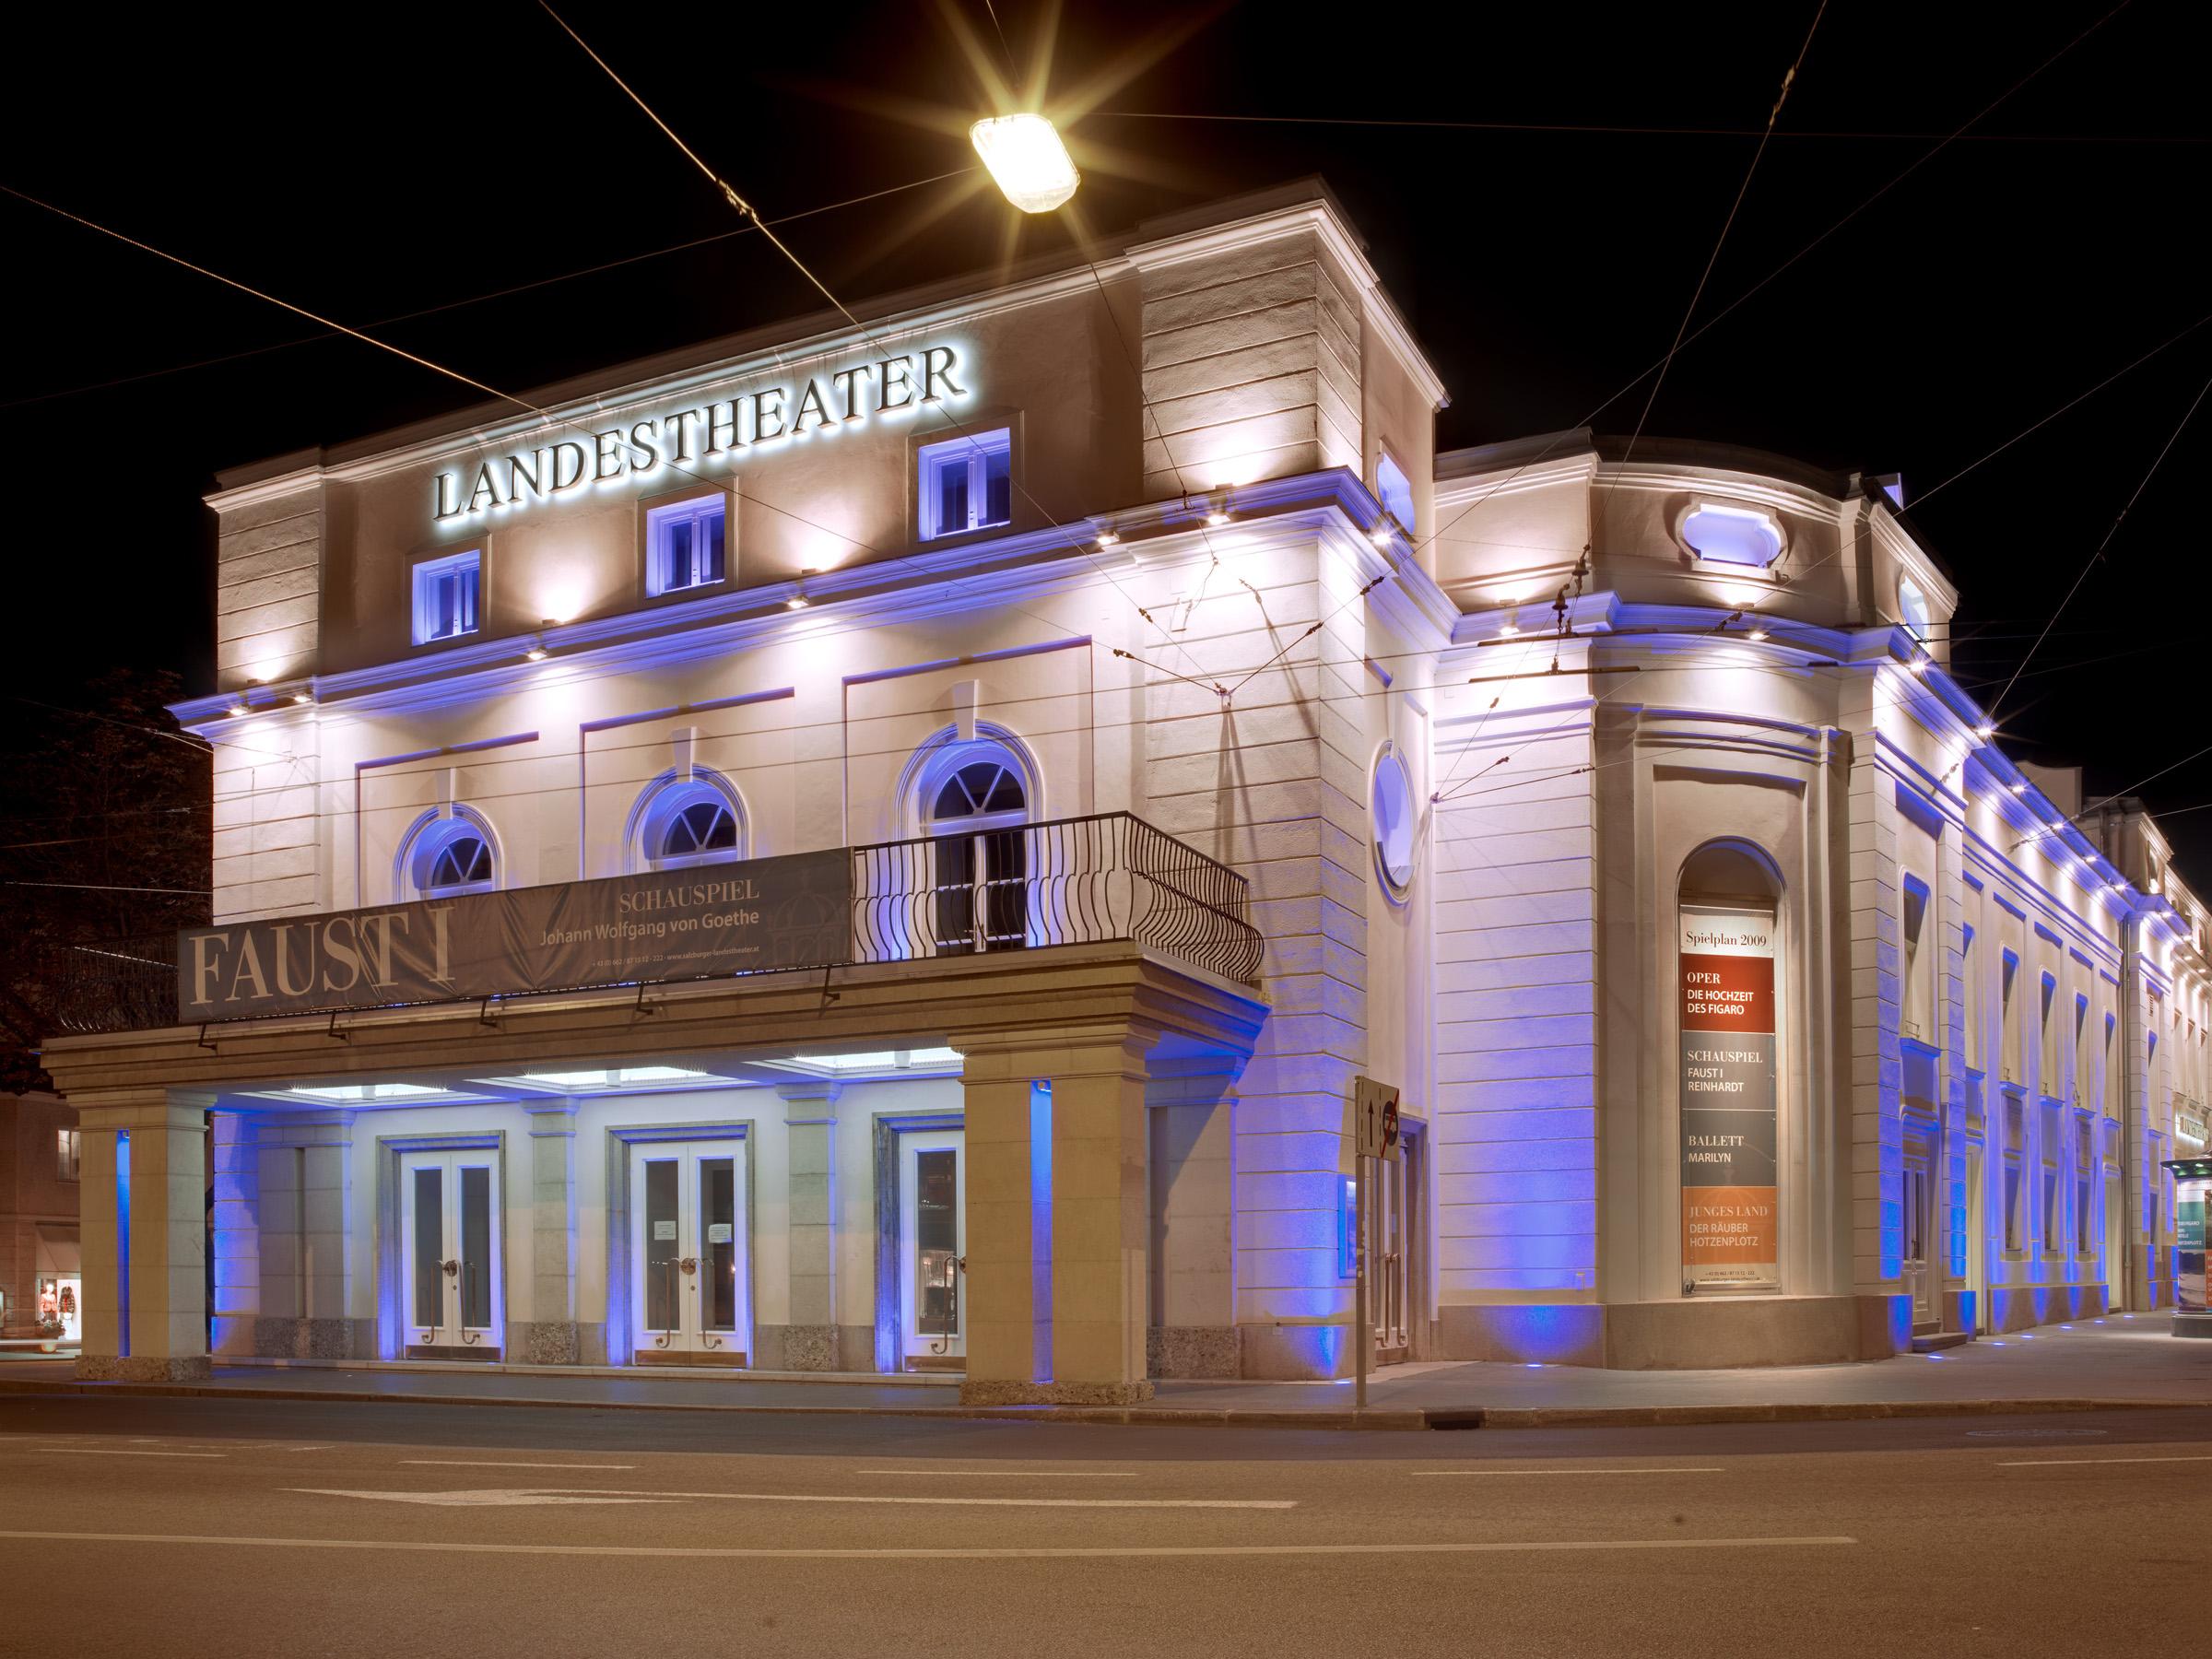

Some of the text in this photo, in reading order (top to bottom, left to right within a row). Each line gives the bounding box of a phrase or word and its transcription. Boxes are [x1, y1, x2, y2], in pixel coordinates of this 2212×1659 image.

[433, 346, 969, 523] LANDESTHEATER
[619, 878, 759, 913] SCHAUSPIEL
[540, 909, 759, 947] Johann Wolfgang von Goethe
[1686, 930, 1767, 947] Spielplan 2009
[189, 906, 456, 1006] FAUST I
[1687, 971, 1721, 984] OPER
[1688, 989, 1754, 1002] DIE HOCHZEIT
[1688, 1003, 1745, 1016] DES FIGARO
[1688, 1050, 1763, 1063] SCHAUSPIEL
[1688, 1067, 1724, 1078] FAUST I
[1688, 1081, 1745, 1092] REINHARDT
[1688, 1135, 1745, 1147] BALLETT
[1688, 1152, 1732, 1163] MARILYN
[1689, 1206, 1768, 1218] JUNGES LAND
[1689, 1220, 1748, 1233] DER RÄUBER
[1689, 1236, 1759, 1247] HOTZENPLOTZ
